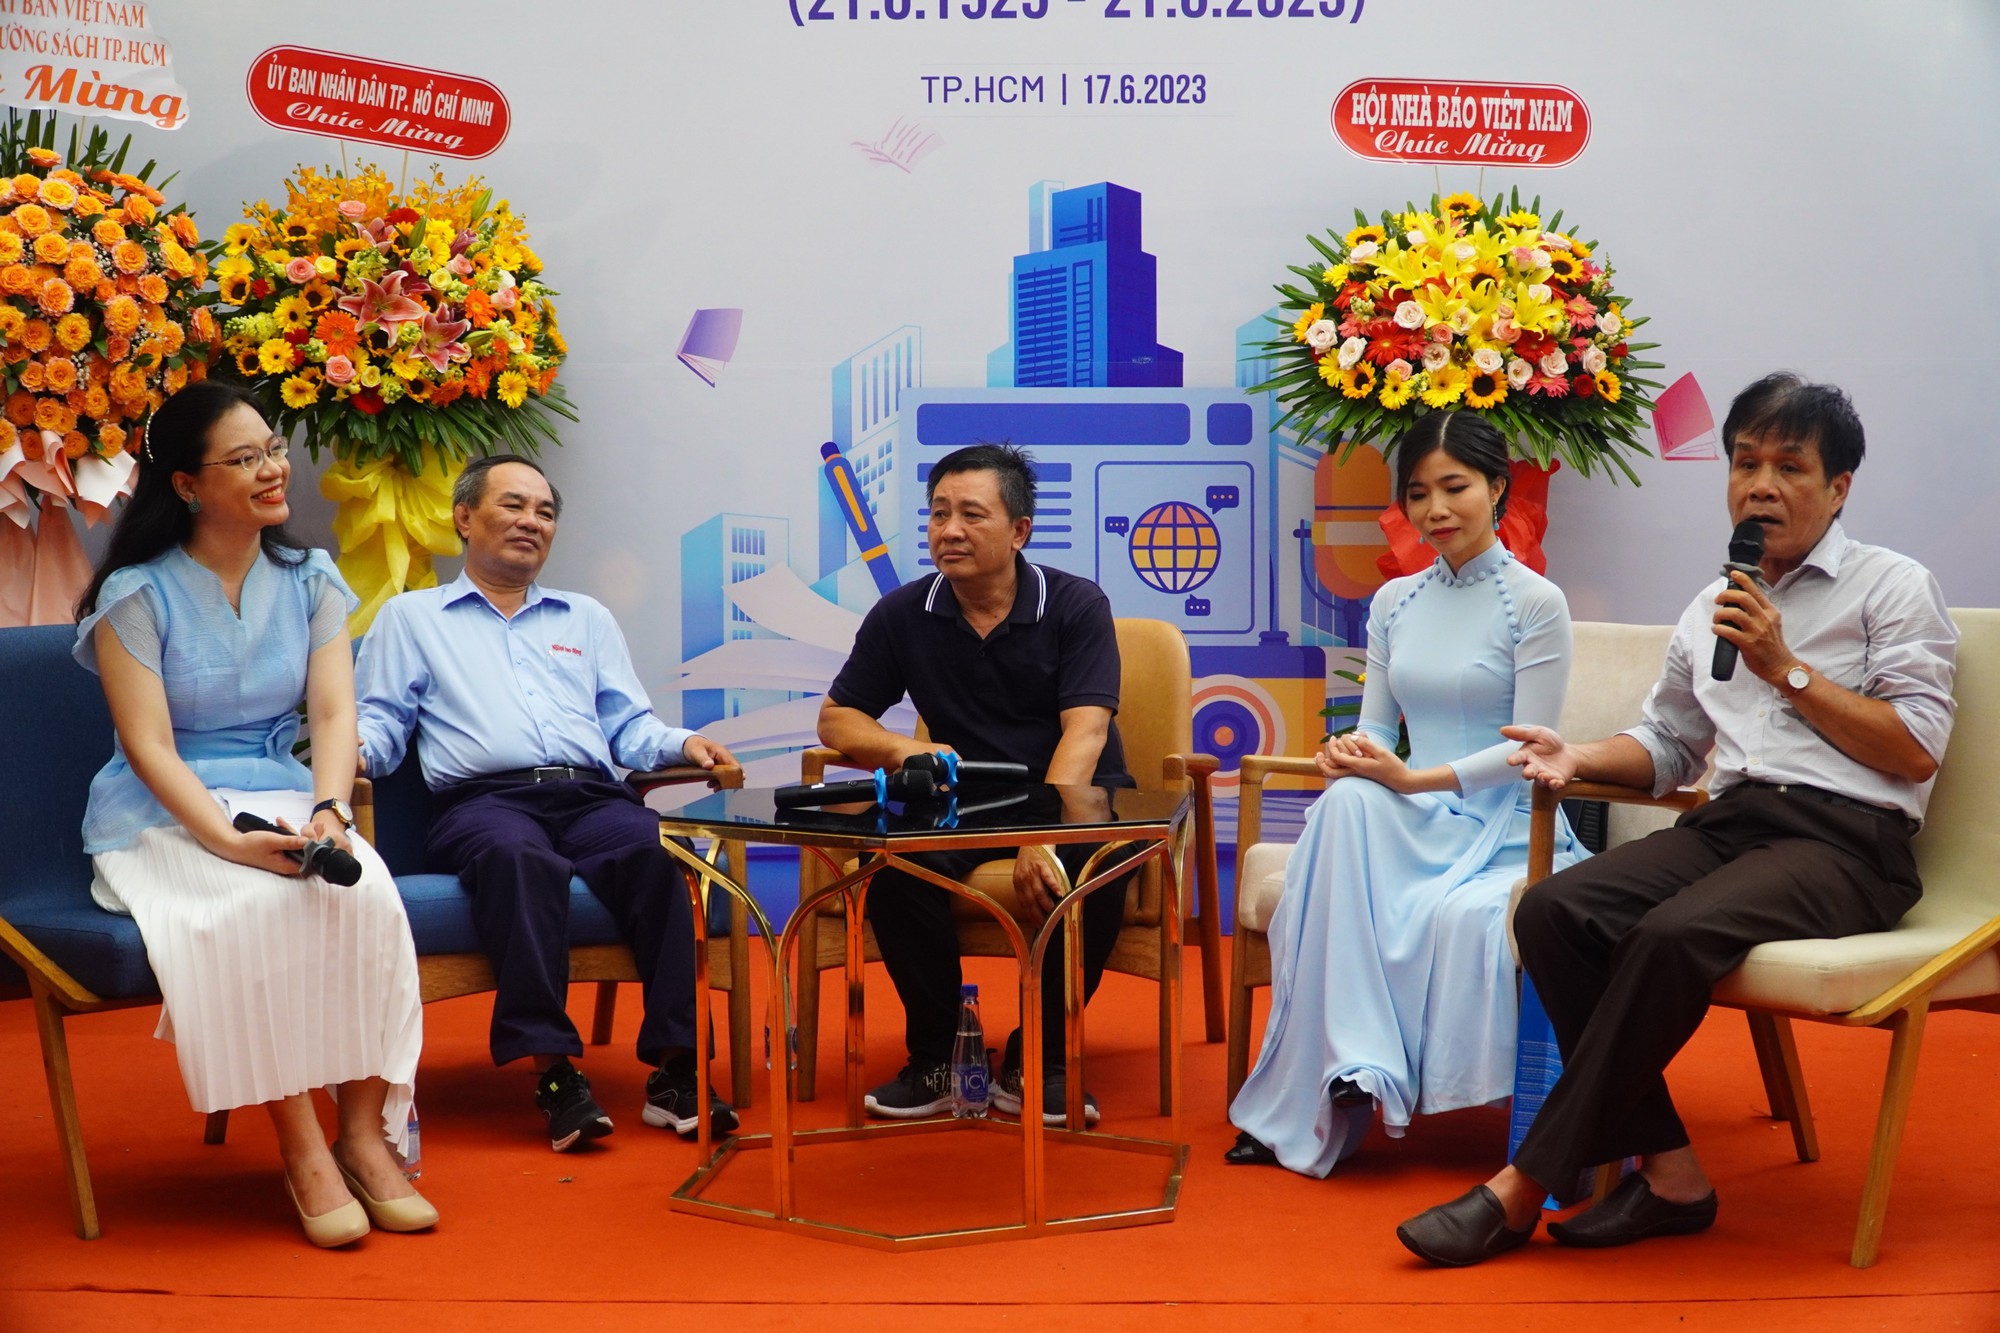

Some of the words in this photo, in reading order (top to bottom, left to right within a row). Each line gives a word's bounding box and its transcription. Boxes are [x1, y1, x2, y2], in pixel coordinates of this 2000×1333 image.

[105, 2, 144, 28] NAM
[51, 28, 98, 59] SÁCH
[103, 37, 166, 66] TP.HCM
[24, 65, 186, 128] Mừng
[267, 54, 287, 90] ỦY
[288, 66, 317, 97] BAN
[318, 68, 357, 102] NHÂN
[358, 74, 387, 108] DÂN
[389, 84, 408, 112] TP.
[412, 80, 434, 116] HỒ
[434, 88, 460, 121] CHÍ
[459, 97, 494, 127] MINH
[920, 75, 1044, 103] TP.HCM
[1084, 74, 1206, 104] 17.6.2023
[286, 102, 364, 130] Chúc
[369, 117, 465, 149] Mừng
[1351, 85, 1386, 133] HỘI
[1390, 86, 1432, 127] NHÀ
[1436, 87, 1477, 129] BÁO
[1481, 89, 1525, 138] VIỆT
[1528, 99, 1574, 132] NAM
[1374, 129, 1449, 155] Chúc
[1454, 131, 1547, 162] Mừng
[965, 1073, 988, 1090] ICY
